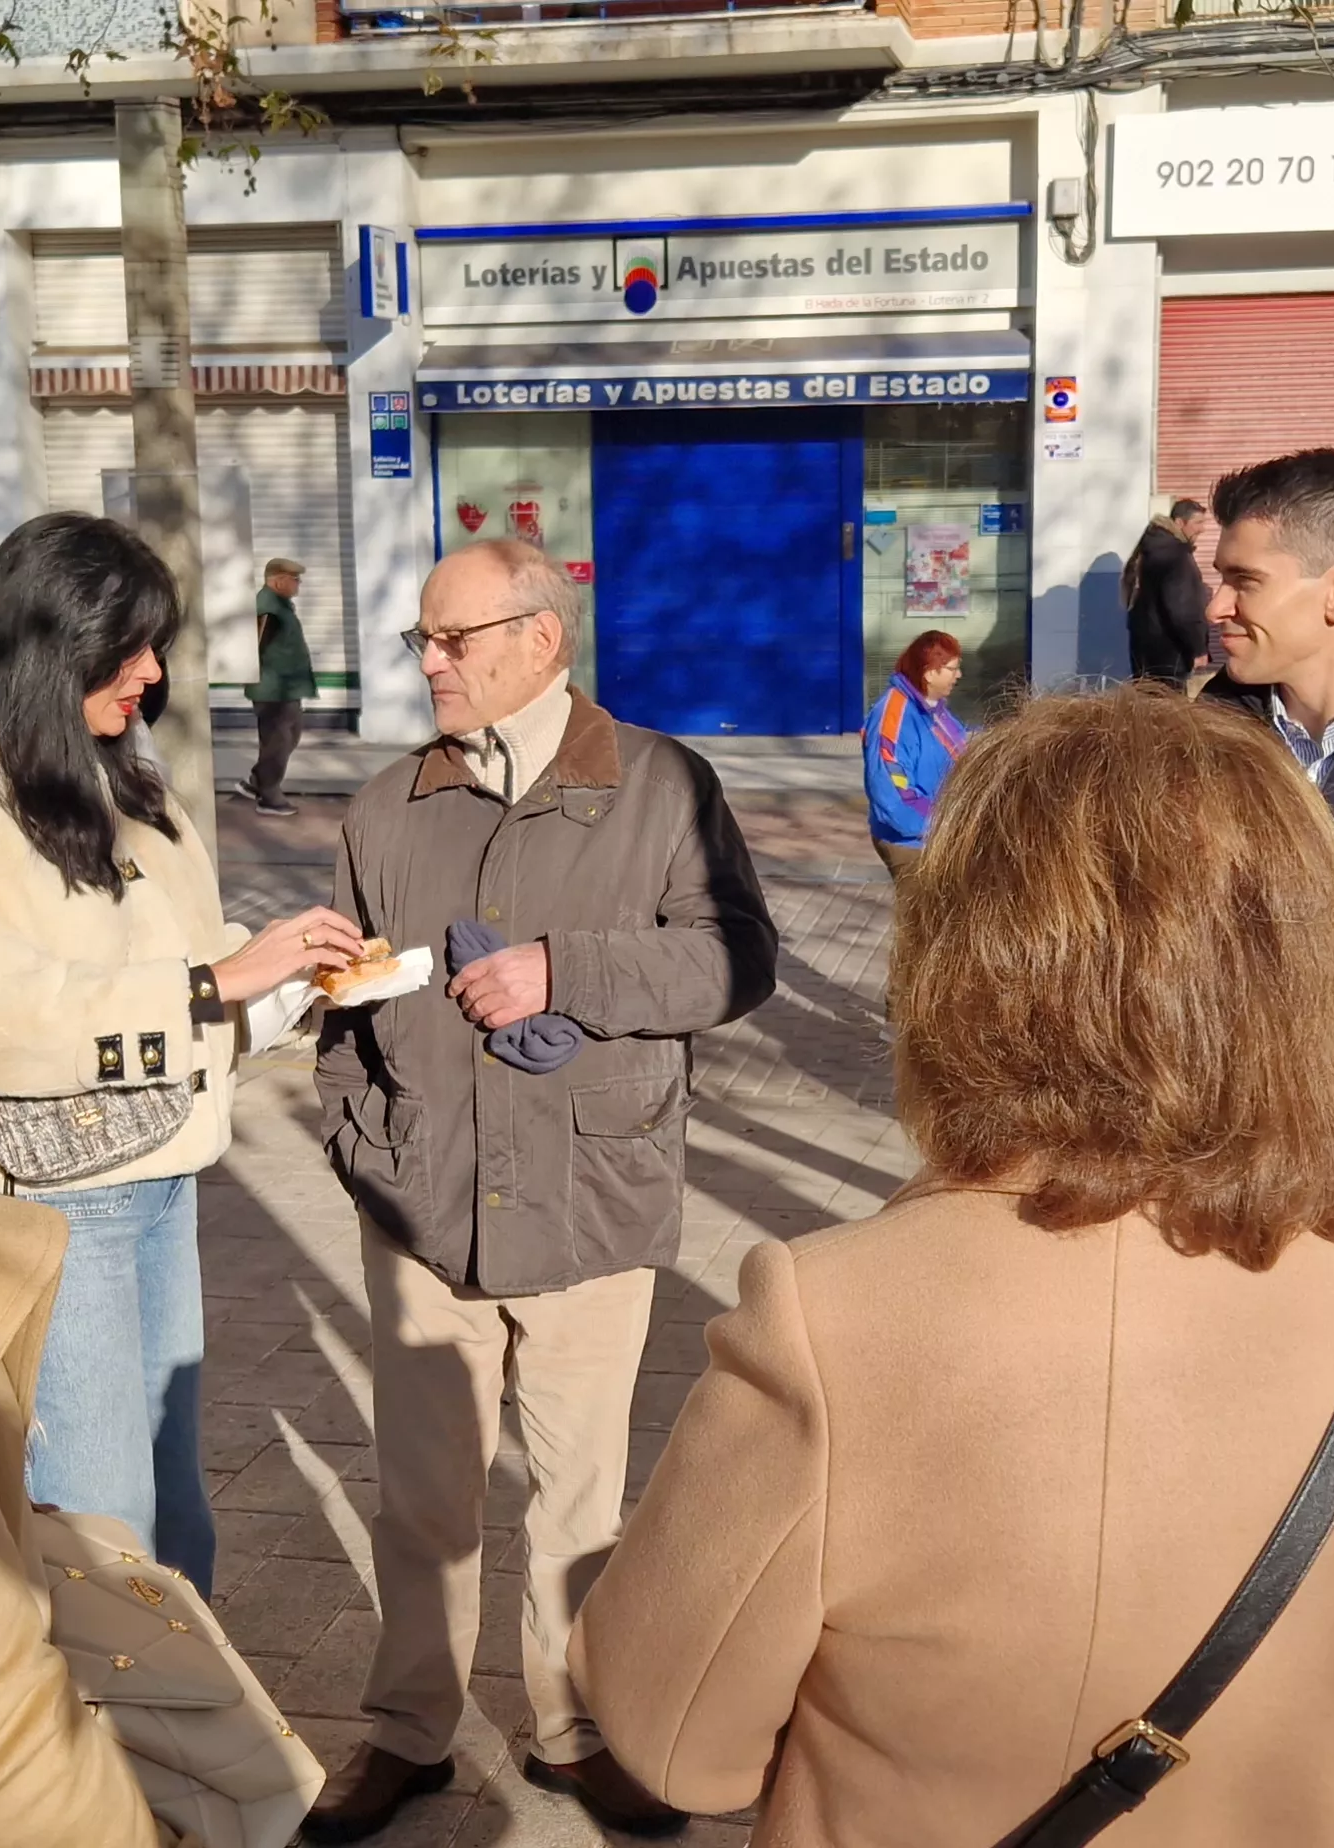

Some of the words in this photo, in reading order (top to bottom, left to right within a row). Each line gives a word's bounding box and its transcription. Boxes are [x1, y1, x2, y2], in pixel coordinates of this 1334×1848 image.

[1156, 159, 1215, 189] 902
[1226, 157, 1265, 186] 20
[1277, 155, 1316, 184] 70
[464, 259, 581, 288] Loterías
[592, 264, 608, 291] y
[676, 253, 815, 287] Apuestas
[826, 248, 872, 277] del
[884, 244, 989, 275] Estado
[874, 296, 916, 307] Fortuna
[457, 381, 591, 404] Loterías
[604, 383, 623, 405] y
[632, 377, 790, 404] Apuestas
[803, 375, 855, 398] del
[870, 372, 991, 397] Estado
